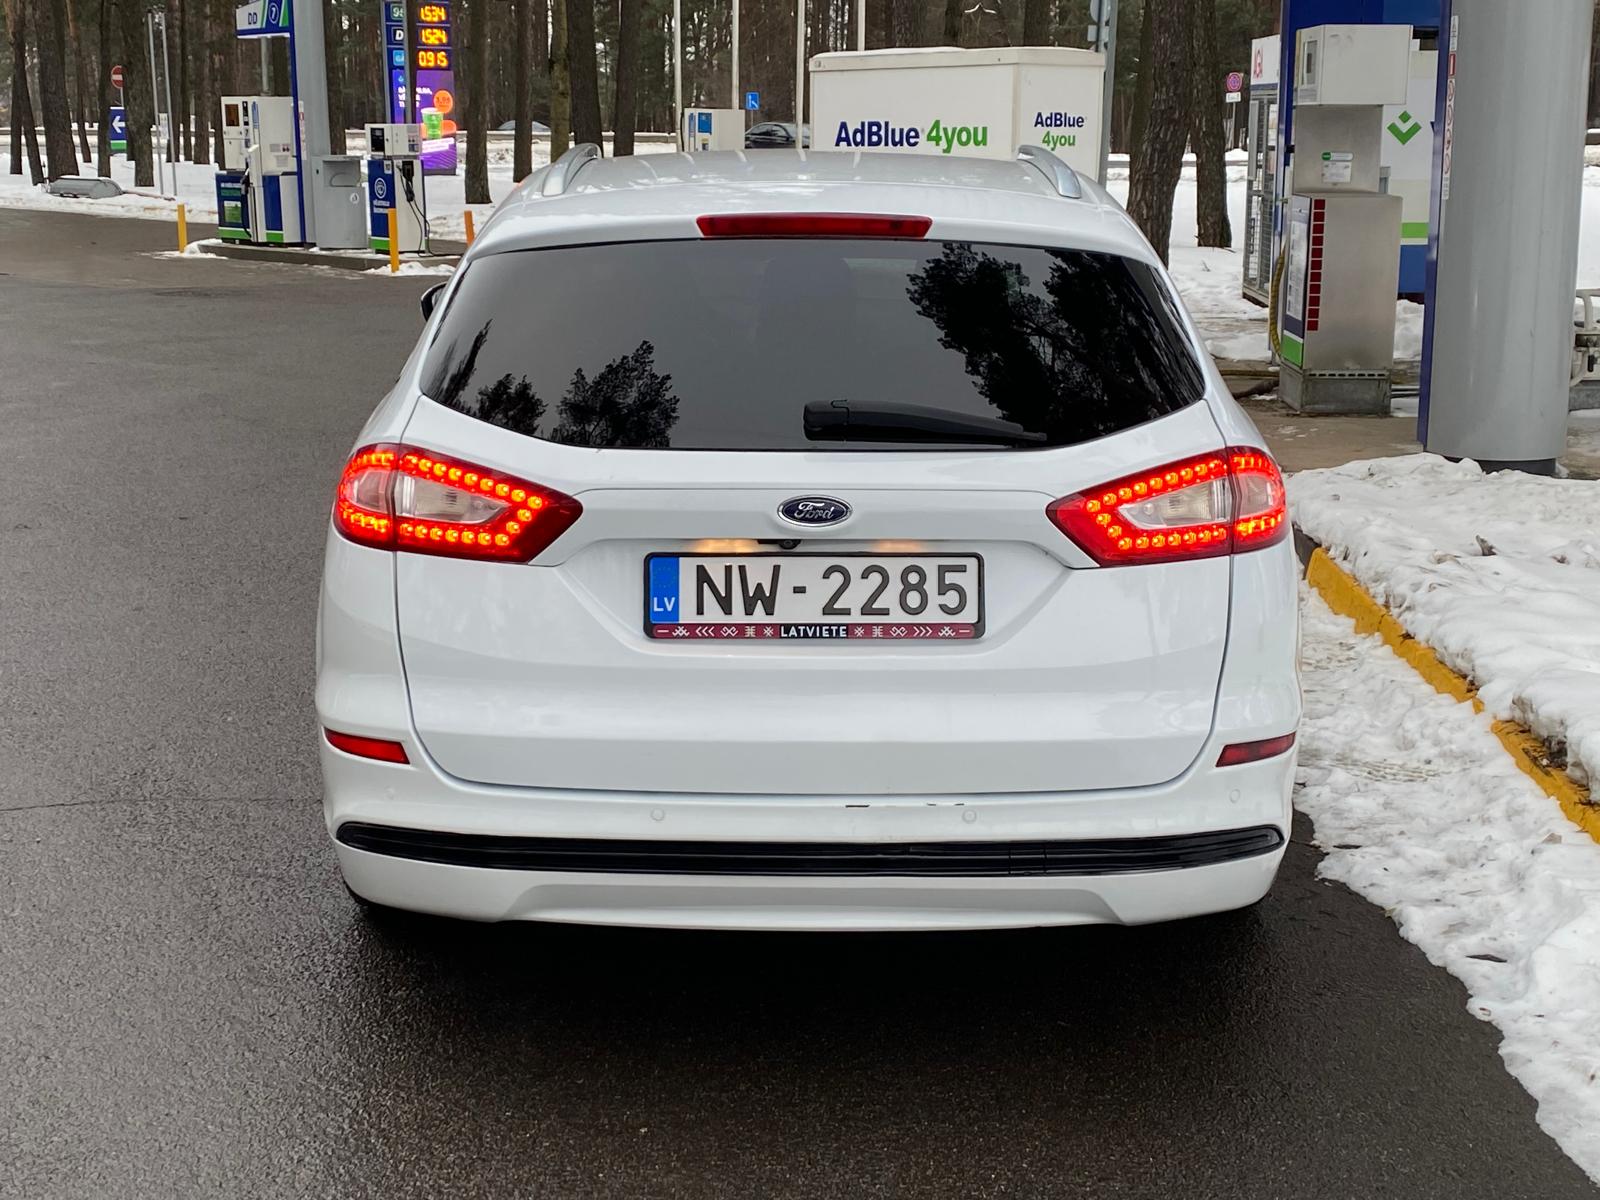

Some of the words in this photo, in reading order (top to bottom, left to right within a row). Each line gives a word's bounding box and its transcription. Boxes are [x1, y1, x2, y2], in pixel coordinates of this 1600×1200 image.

[248, 12, 258, 25] DD
[1033, 111, 1085, 128] AdBlue
[835, 121, 920, 147] AdBlue
[926, 119, 988, 154] 4you
[1042, 130, 1076, 152] 4you
[794, 502, 835, 521] Ford
[696, 564, 968, 616] NW-2285
[653, 597, 676, 612] LV
[780, 625, 847, 638] LATVIETE
